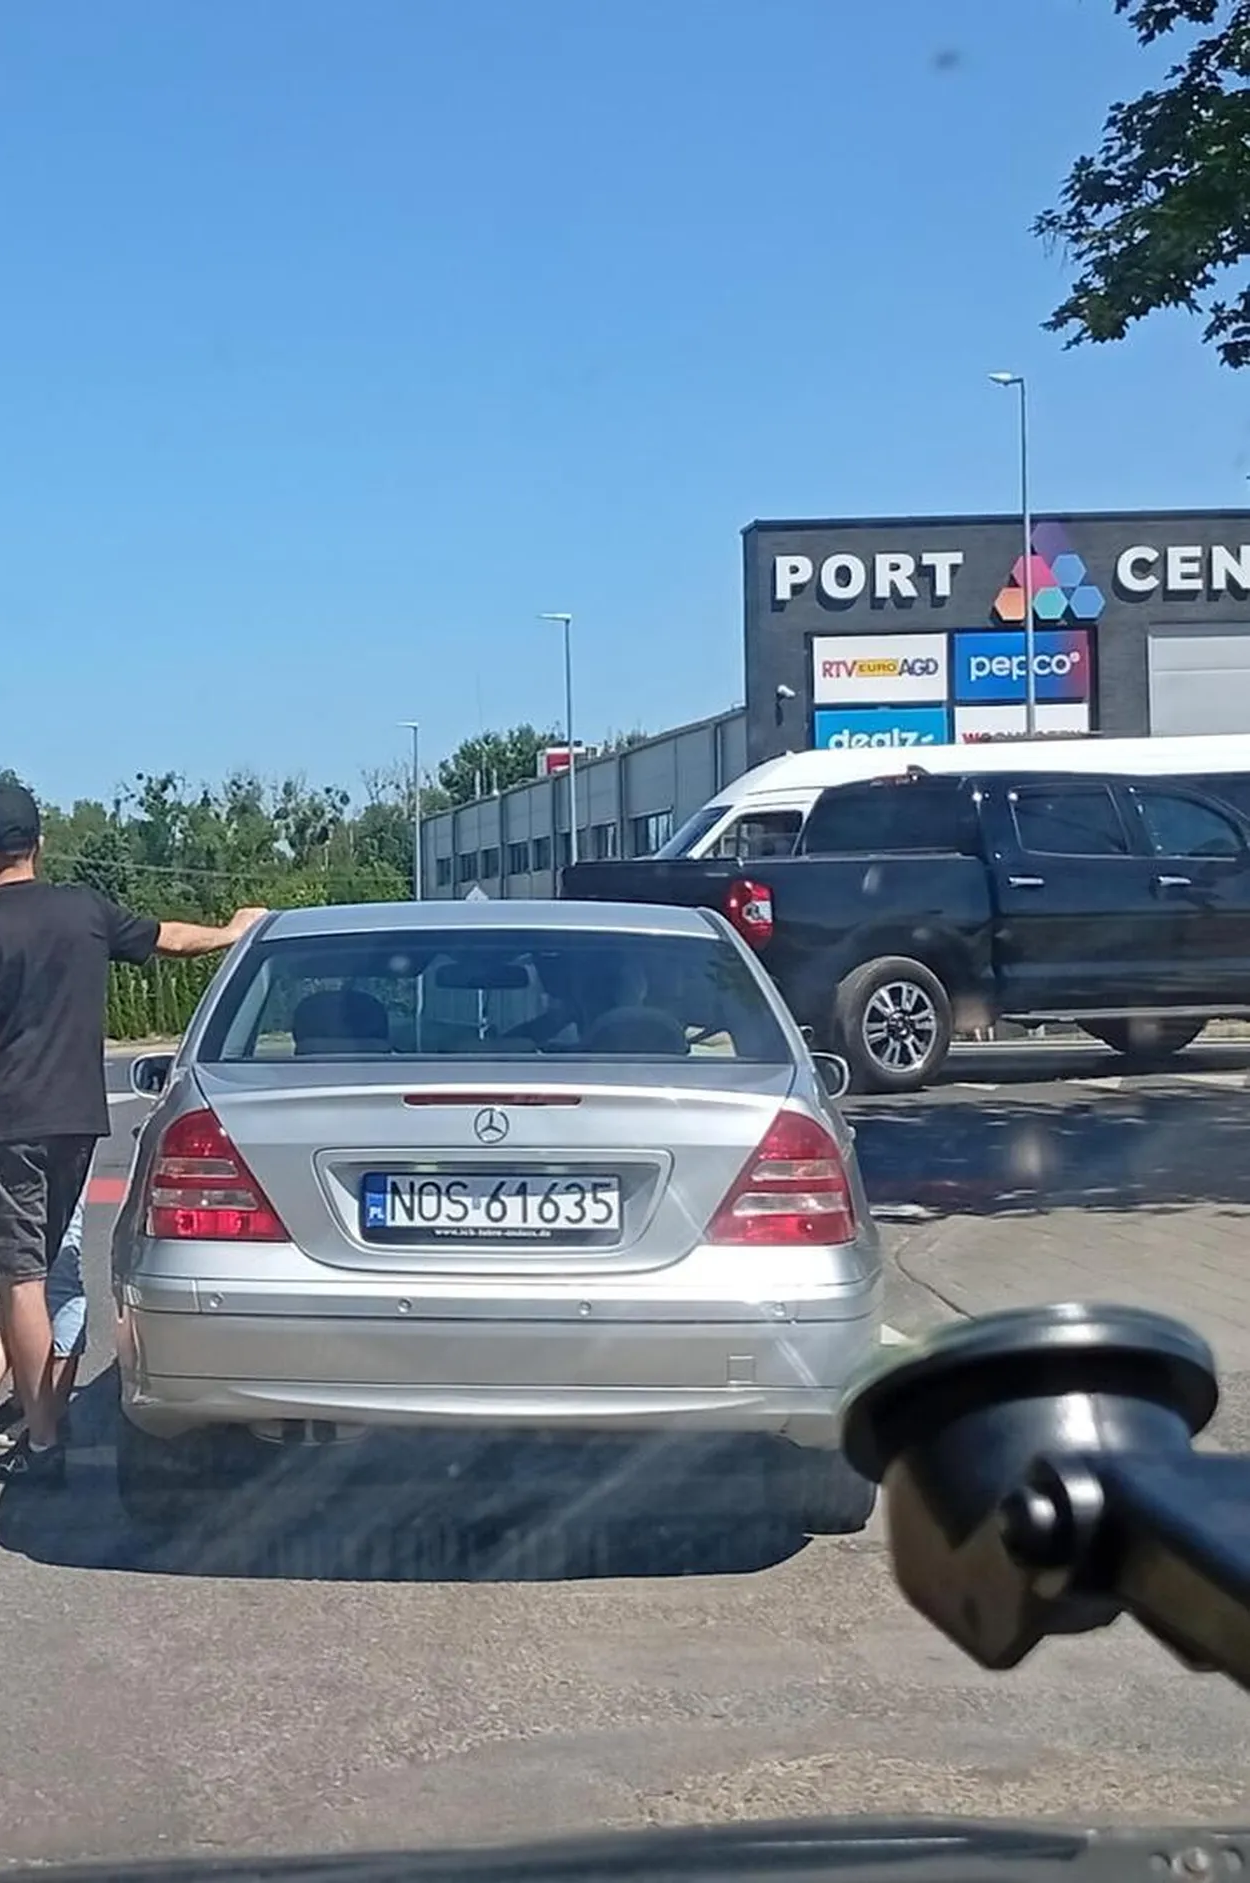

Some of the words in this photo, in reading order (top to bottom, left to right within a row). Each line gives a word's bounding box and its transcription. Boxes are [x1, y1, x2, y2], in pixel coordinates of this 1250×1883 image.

[775, 552, 964, 600] PORT
[1116, 544, 1250, 592] CEN
[822, 660, 857, 678] RTV
[898, 658, 939, 677] AGD
[969, 653, 1071, 681] pepco
[390, 1180, 469, 1222] NOS
[485, 1180, 613, 1224] 61635
